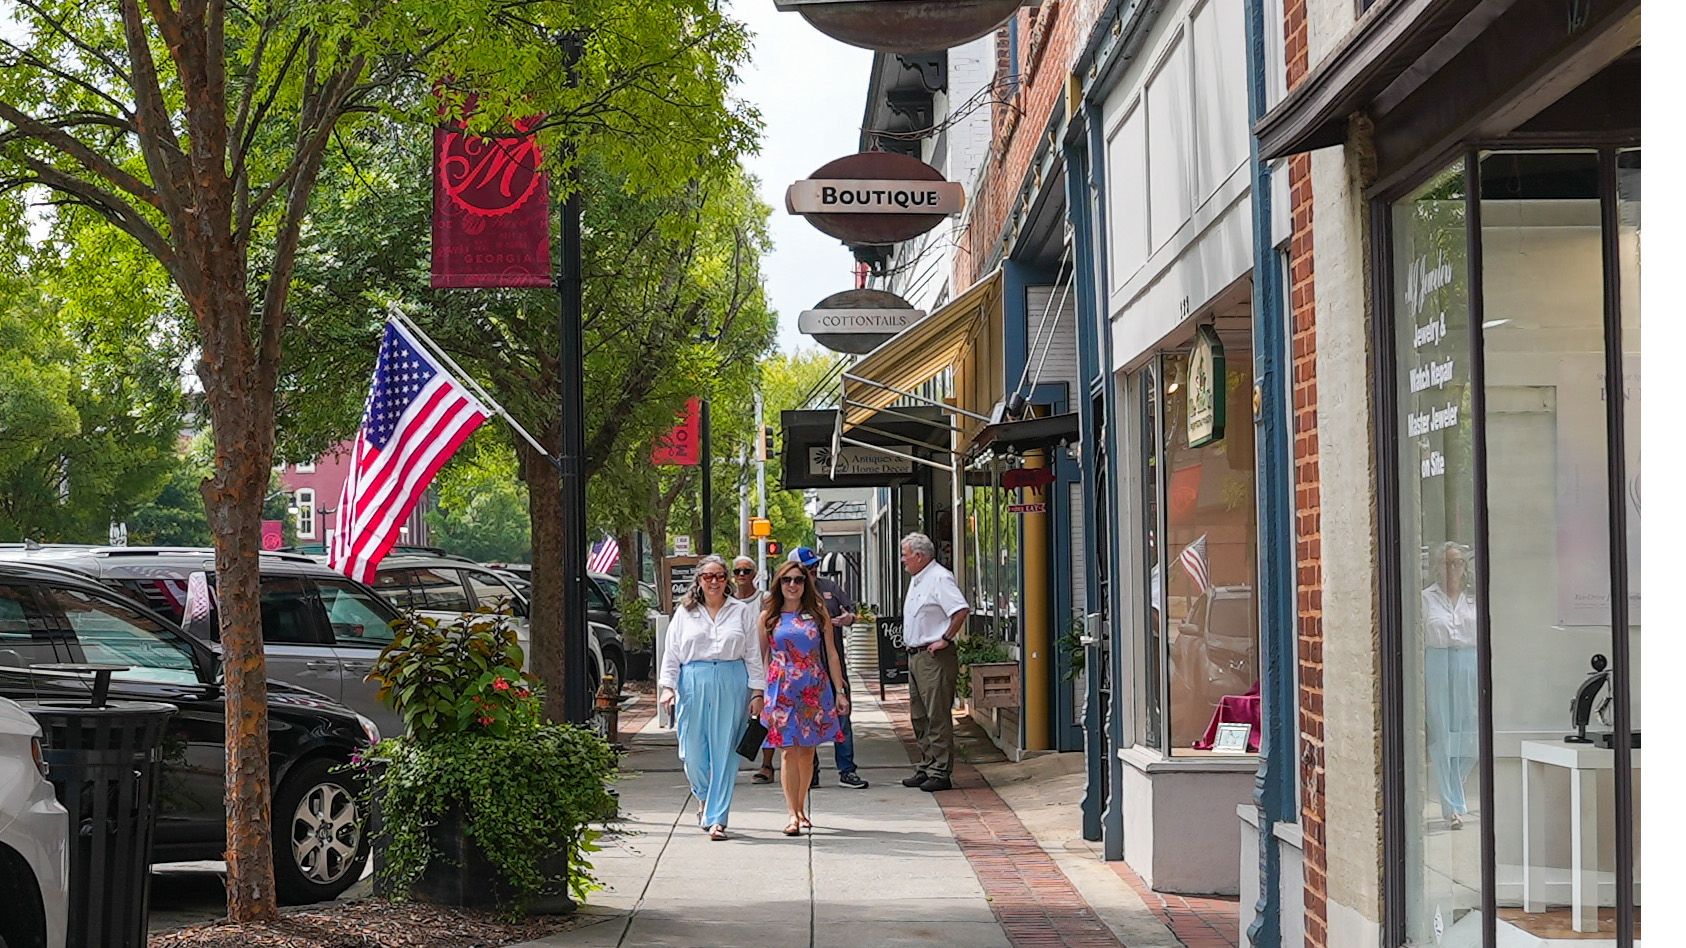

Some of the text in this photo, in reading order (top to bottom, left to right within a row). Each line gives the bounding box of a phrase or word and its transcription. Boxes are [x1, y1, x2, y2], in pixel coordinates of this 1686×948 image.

[822, 187, 937, 208] BOUTIQUE
[465, 254, 532, 263] GEORGIA
[822, 316, 907, 326] COTTONTAILS
[1414, 311, 1447, 348] Jewelry &
[1409, 355, 1453, 393] Watch Repair
[1407, 401, 1458, 438] Master Jeweler
[1430, 451, 1445, 477] Site
